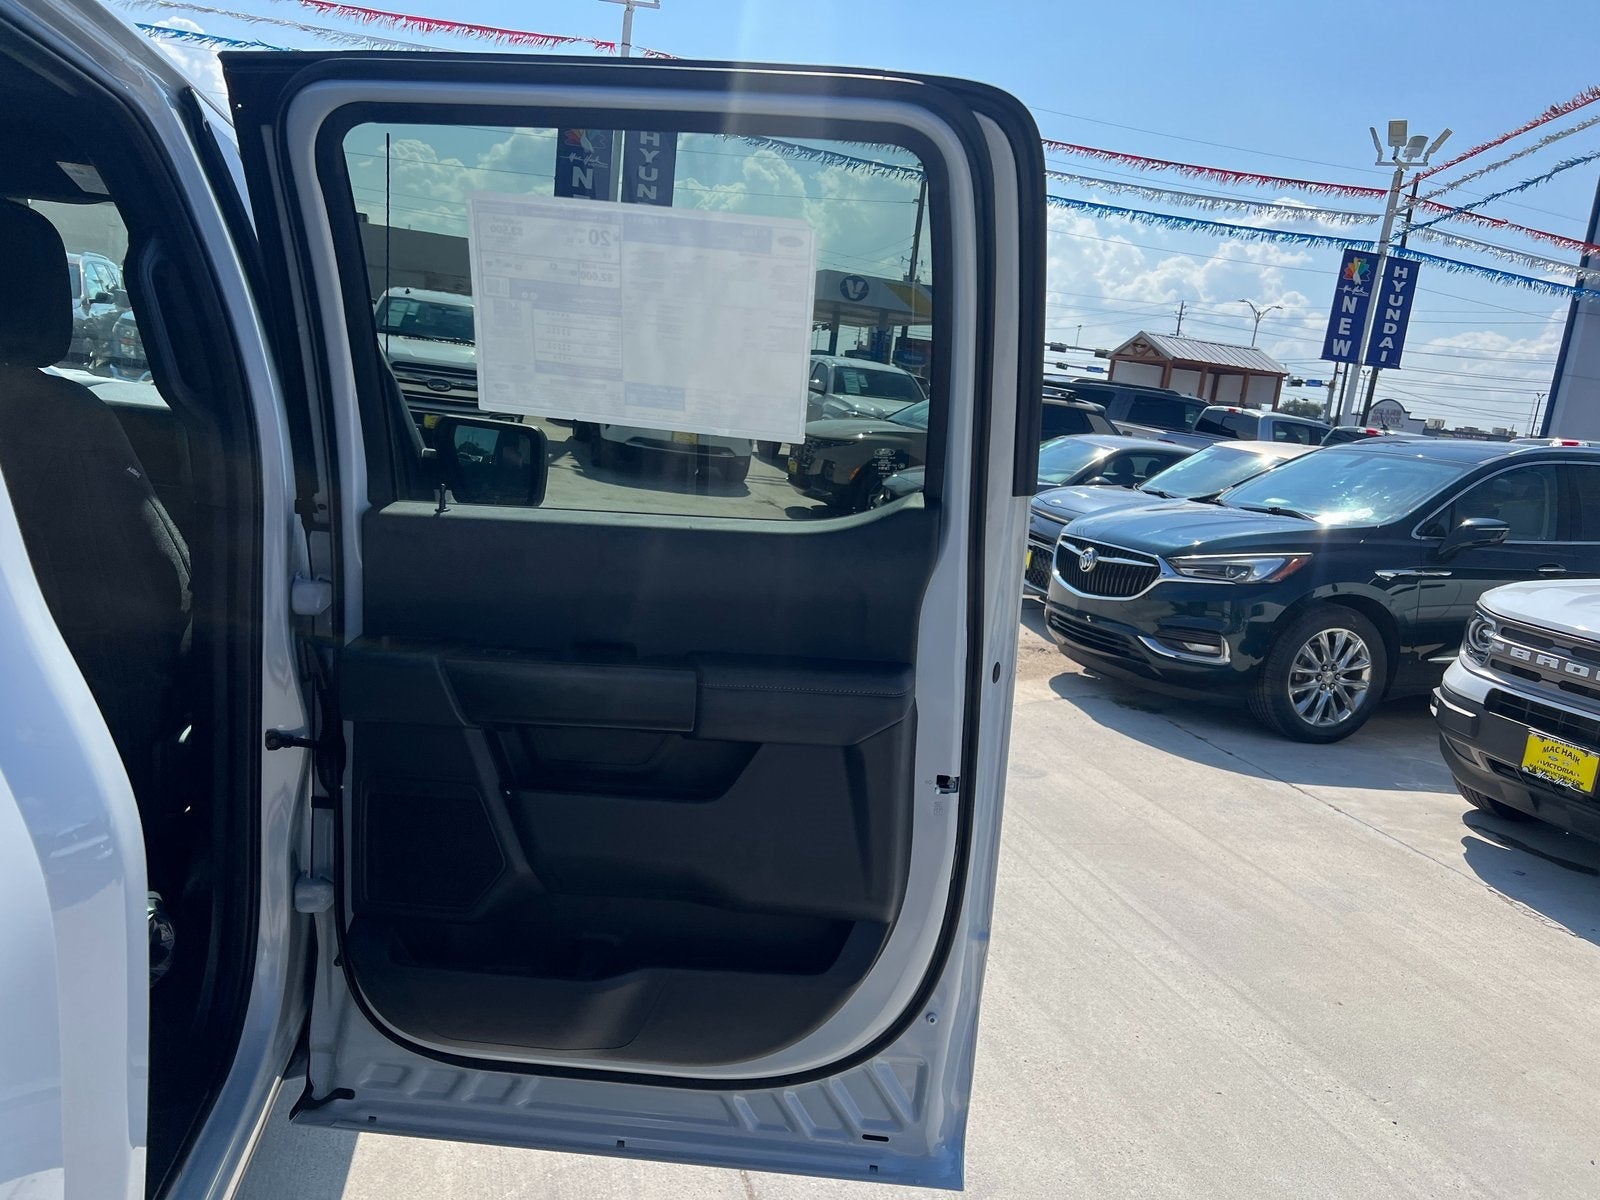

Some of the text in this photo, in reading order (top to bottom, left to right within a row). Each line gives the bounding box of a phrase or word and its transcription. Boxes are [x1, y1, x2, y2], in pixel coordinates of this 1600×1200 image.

[637, 131, 660, 204] HYUN
[1332, 295, 1358, 357] NEW
[1378, 266, 1409, 362] HYUNDAI
[1509, 646, 1600, 681] BRO
[1542, 745, 1581, 766] MAC HAIK
